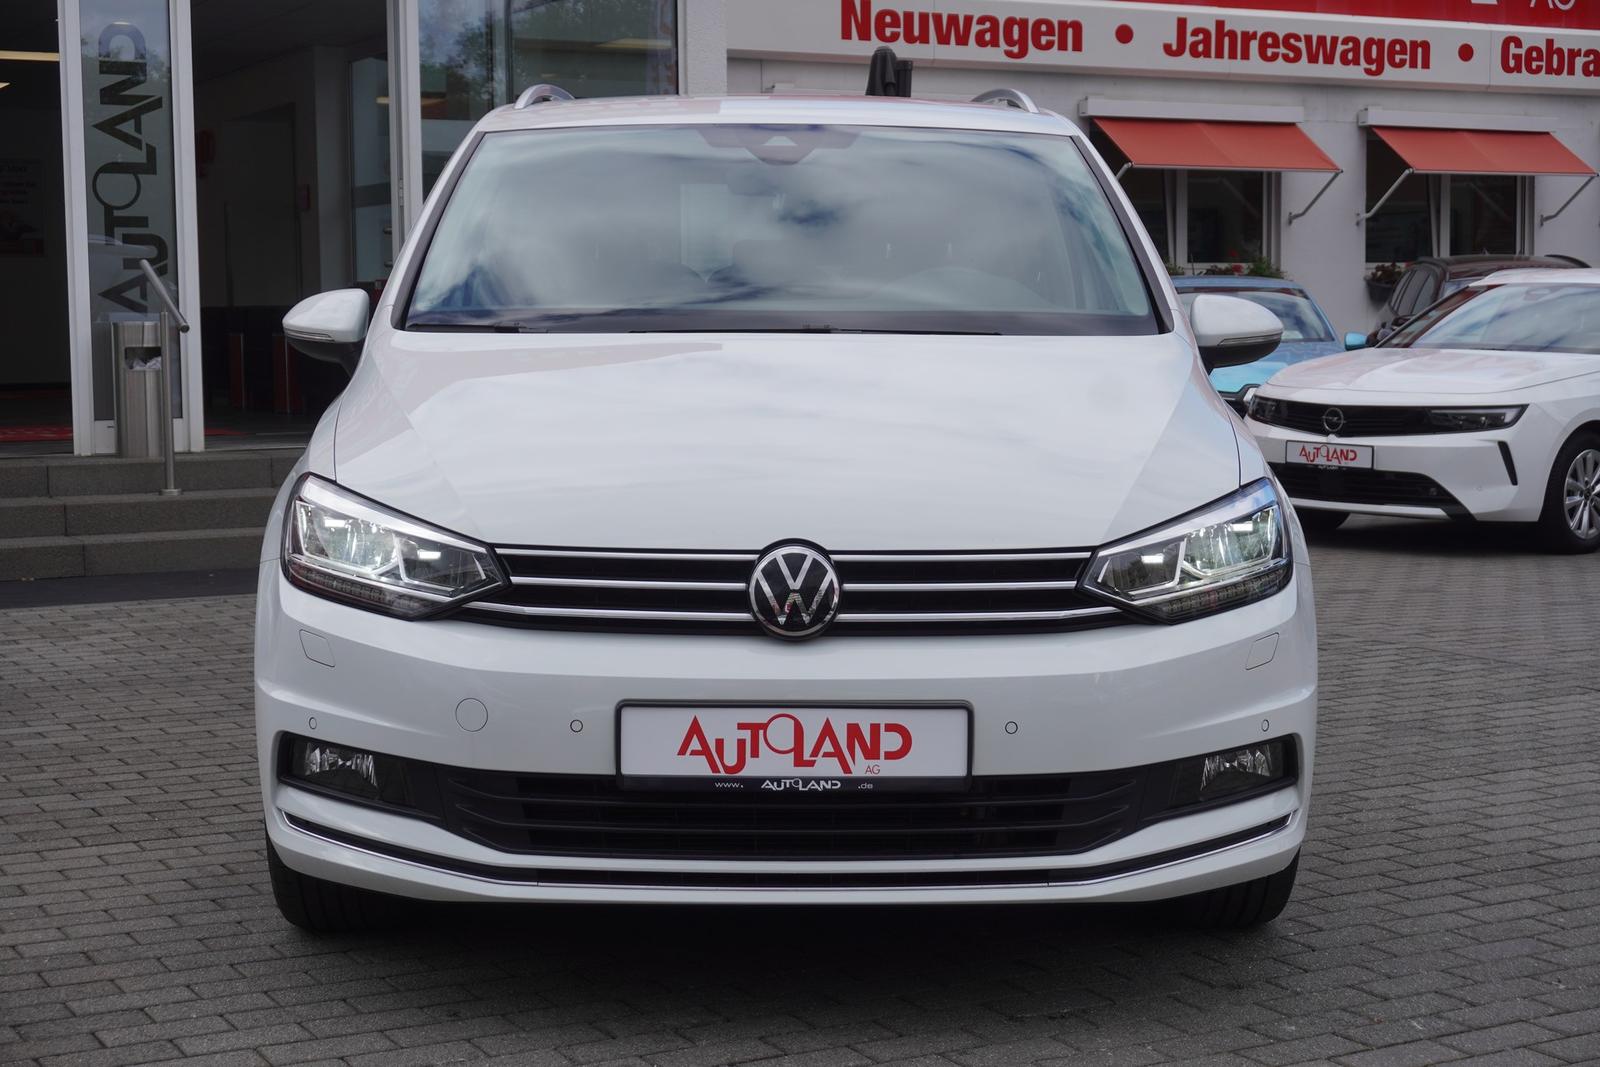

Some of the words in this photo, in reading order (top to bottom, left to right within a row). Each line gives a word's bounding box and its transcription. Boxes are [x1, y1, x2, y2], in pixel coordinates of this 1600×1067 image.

[841, 0, 1082, 58] Neuwagen
[1163, 17, 1431, 76] Jahreswagen
[92, 23, 168, 313] AUTOLAND
[677, 713, 912, 774] AUTOLAND
[865, 765, 880, 774] AG
